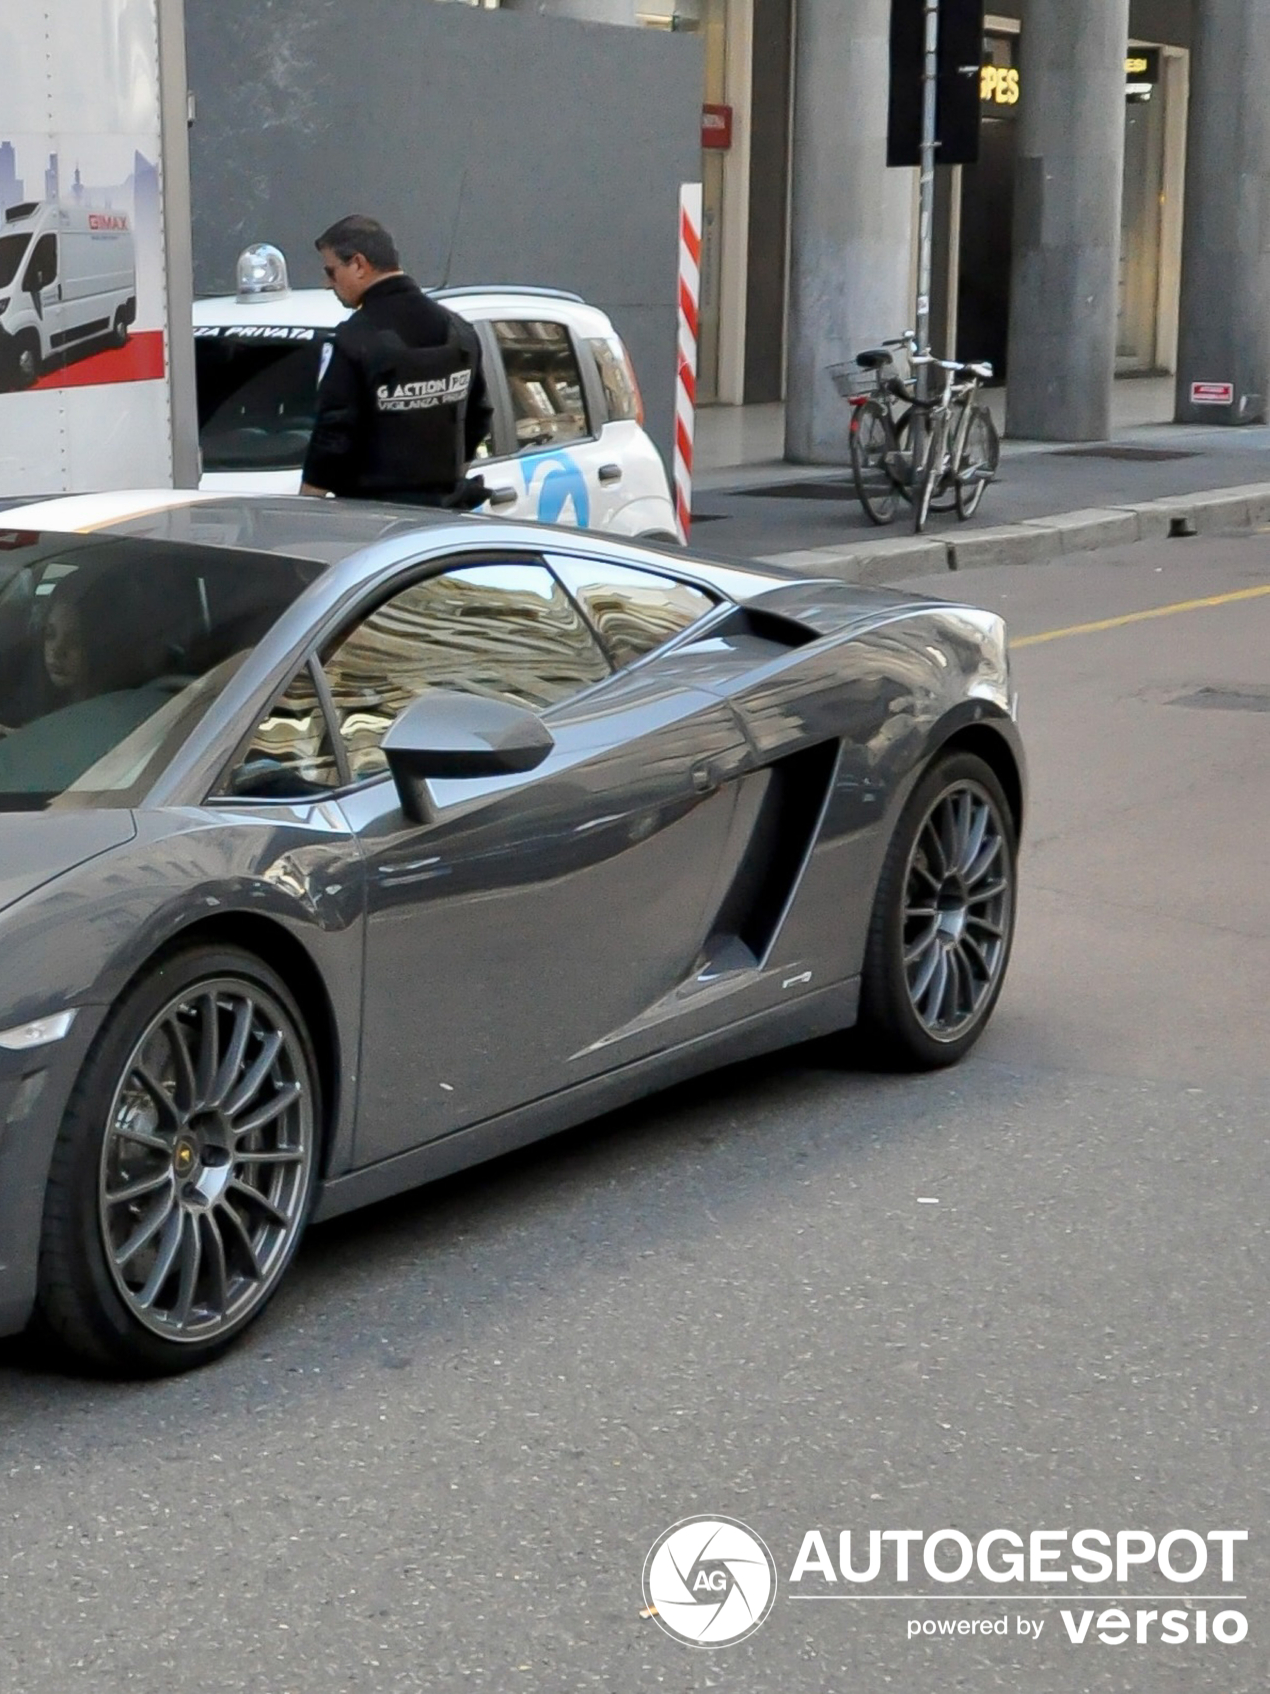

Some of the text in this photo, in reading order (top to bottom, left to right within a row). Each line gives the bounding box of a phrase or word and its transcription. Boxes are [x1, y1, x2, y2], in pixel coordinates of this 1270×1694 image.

[88, 213, 129, 232] GIMAX
[224, 327, 315, 341] PRIVATA
[393, 378, 447, 397] ACTION
